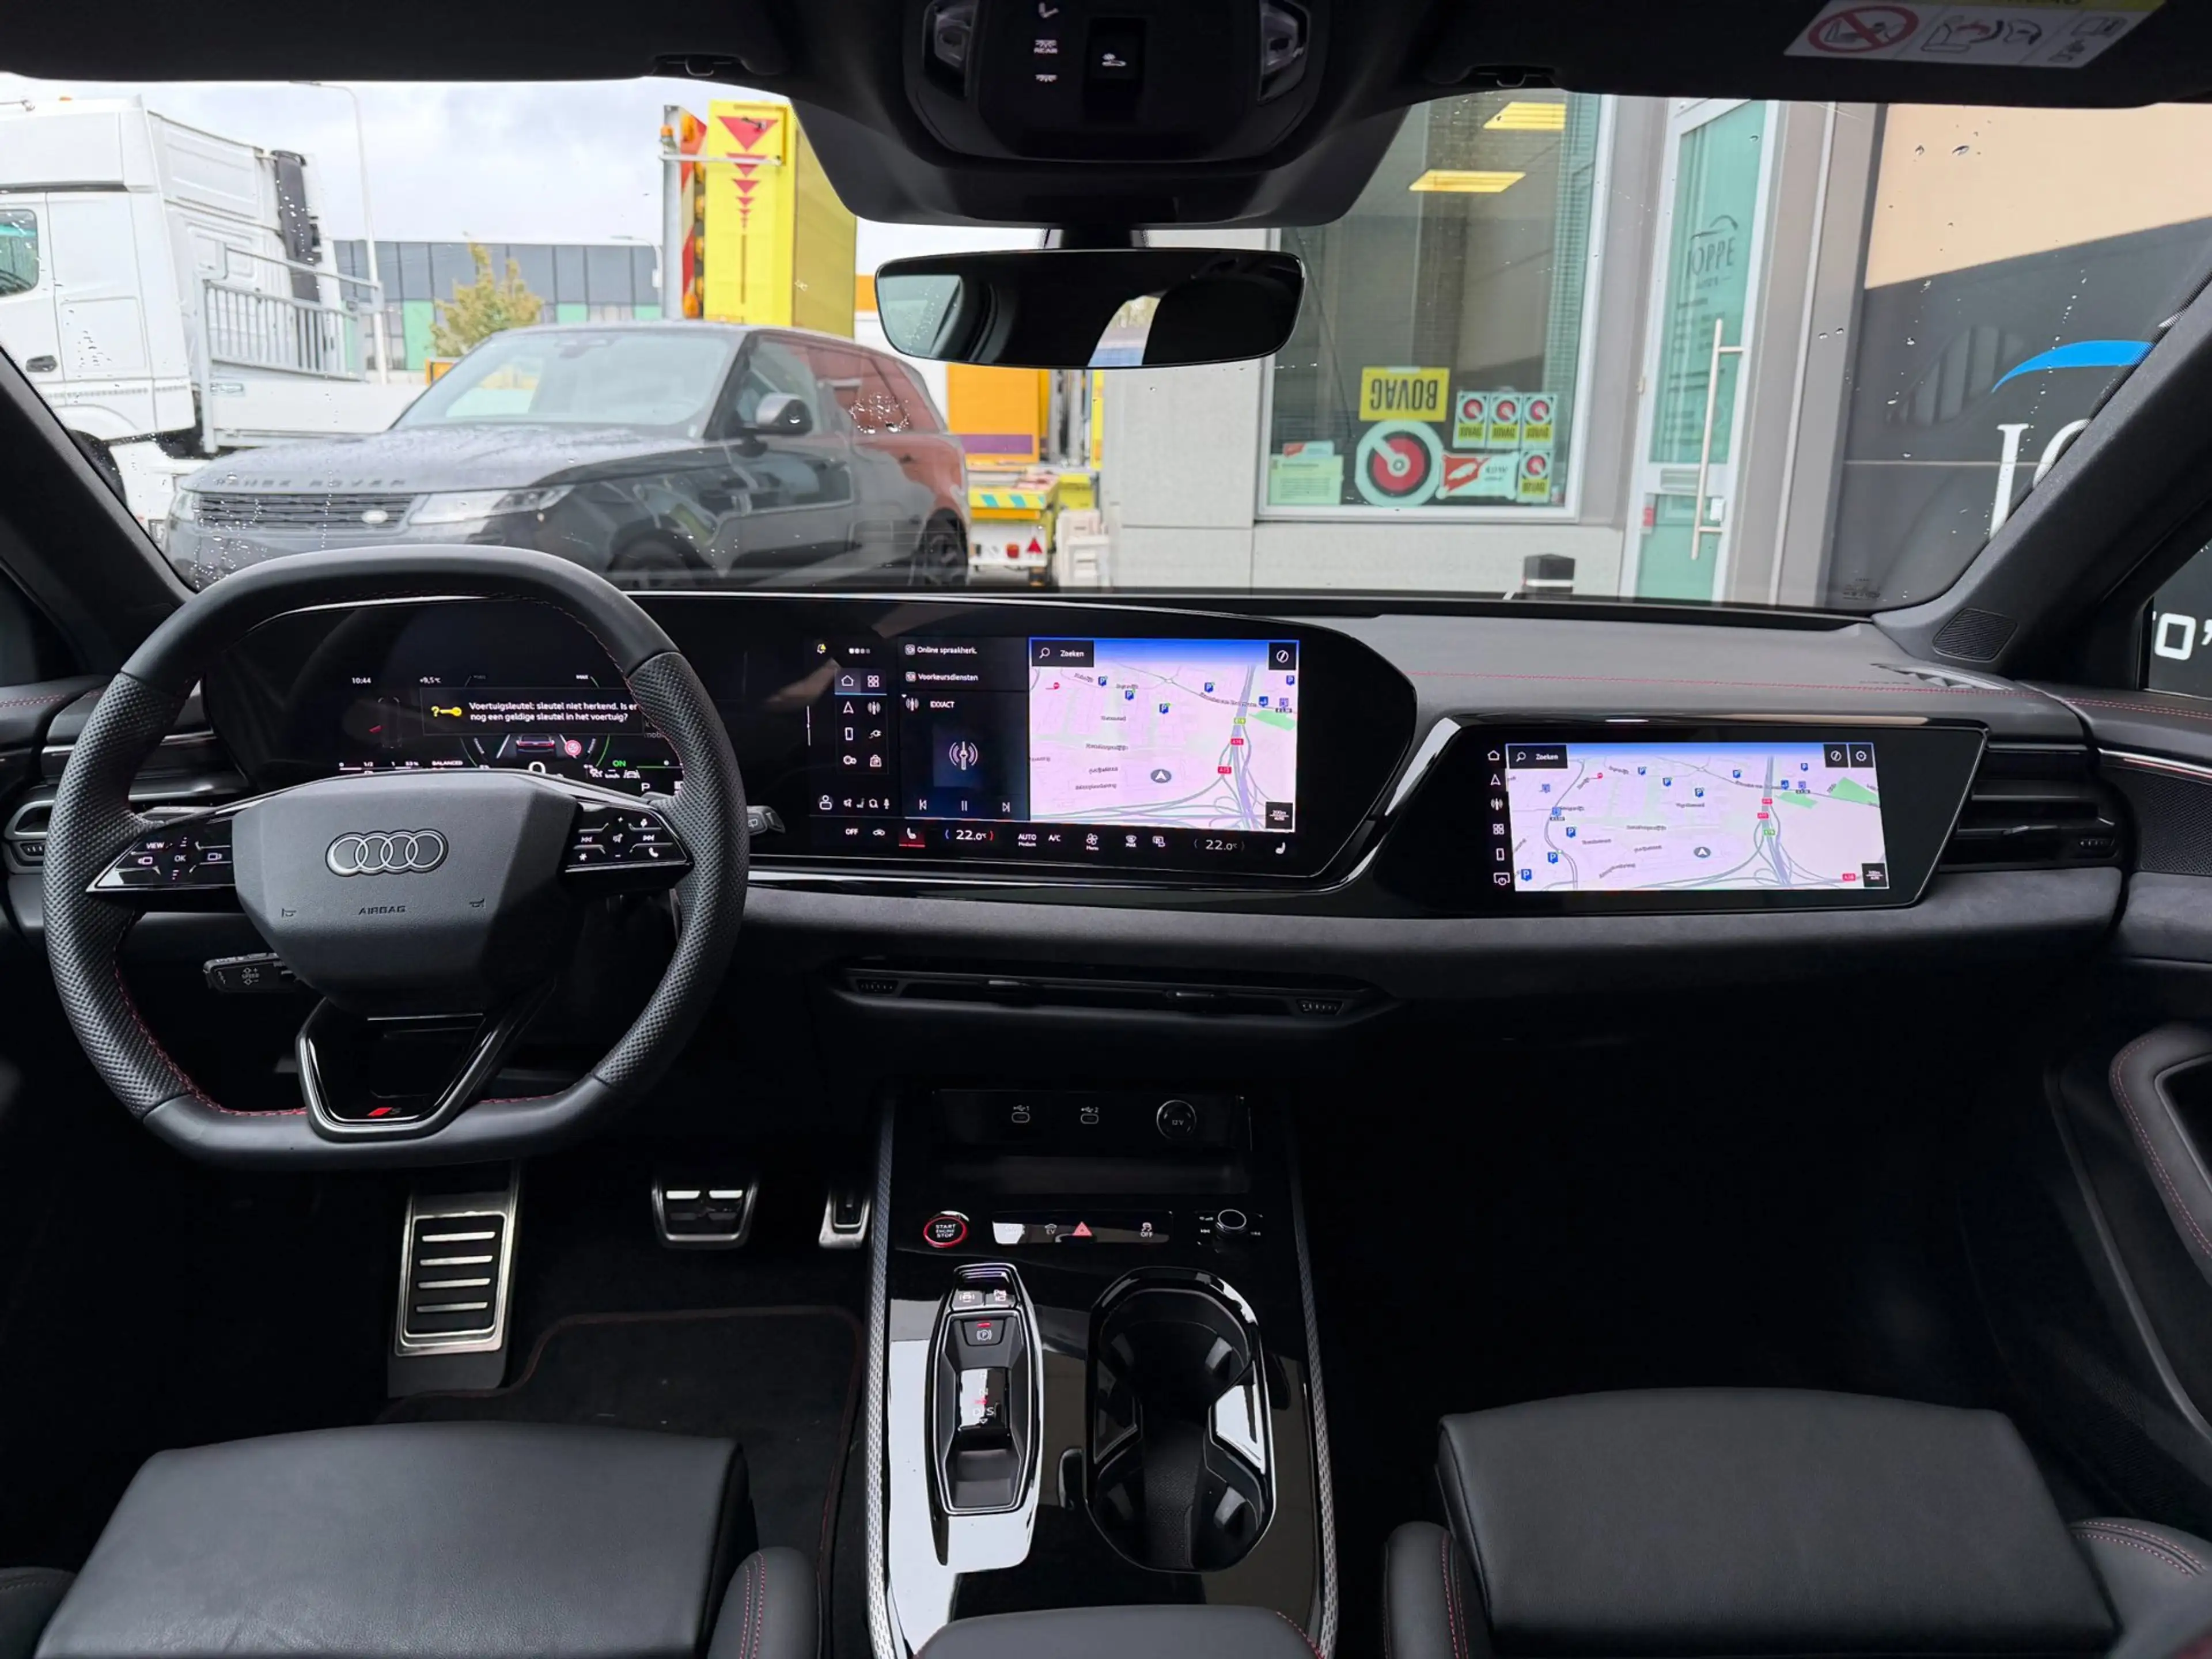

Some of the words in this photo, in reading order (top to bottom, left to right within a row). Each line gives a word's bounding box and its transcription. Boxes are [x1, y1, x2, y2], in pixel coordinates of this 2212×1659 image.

[1370, 378, 1438, 411] BOVAG
[468, 702, 536, 712] Voertuigsleutel:
[536, 702, 565, 710] sleutel
[566, 702, 583, 710] niet
[584, 702, 619, 711] herkend.
[469, 713, 487, 723] nog
[488, 713, 505, 721] een
[505, 711, 535, 723] geldige
[536, 712, 565, 721] sleutel
[591, 713, 628, 722] voertuig?
[358, 906, 406, 916] AIRBAG
